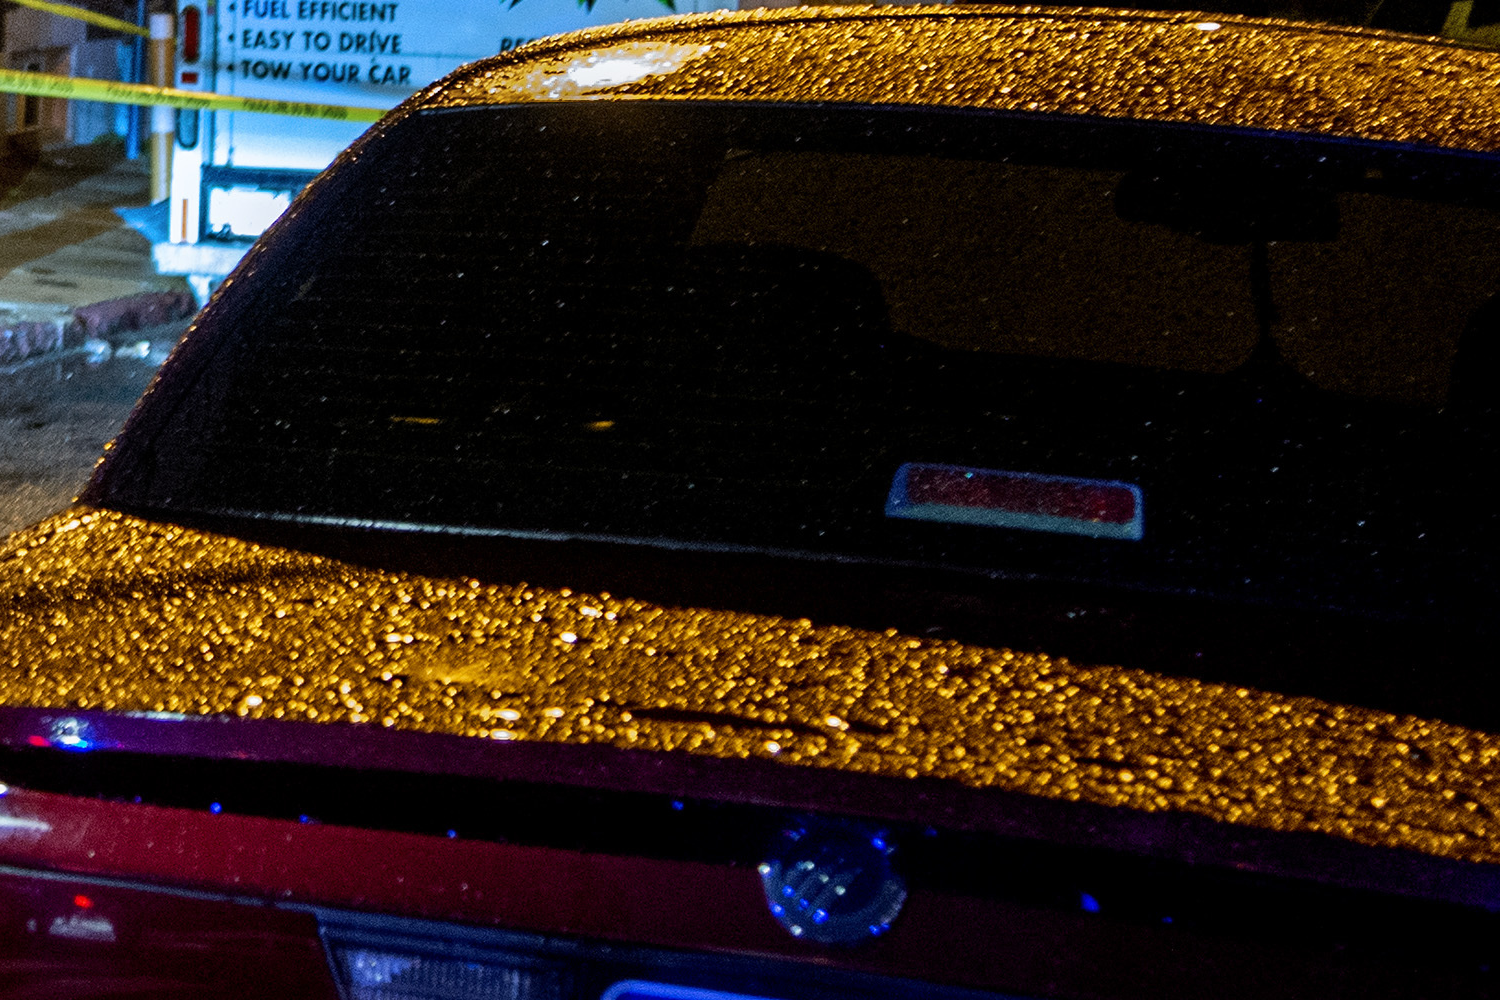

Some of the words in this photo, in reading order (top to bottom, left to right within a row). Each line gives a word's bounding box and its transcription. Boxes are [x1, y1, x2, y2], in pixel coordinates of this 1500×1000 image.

[298, 0, 399, 22] EFFICIENT
[242, 28, 295, 50] EASY
[302, 30, 331, 51] TO
[339, 31, 402, 54] DRIVE
[241, 59, 293, 81] TOW
[300, 61, 361, 84] YOUR
[368, 63, 412, 86] CAR
